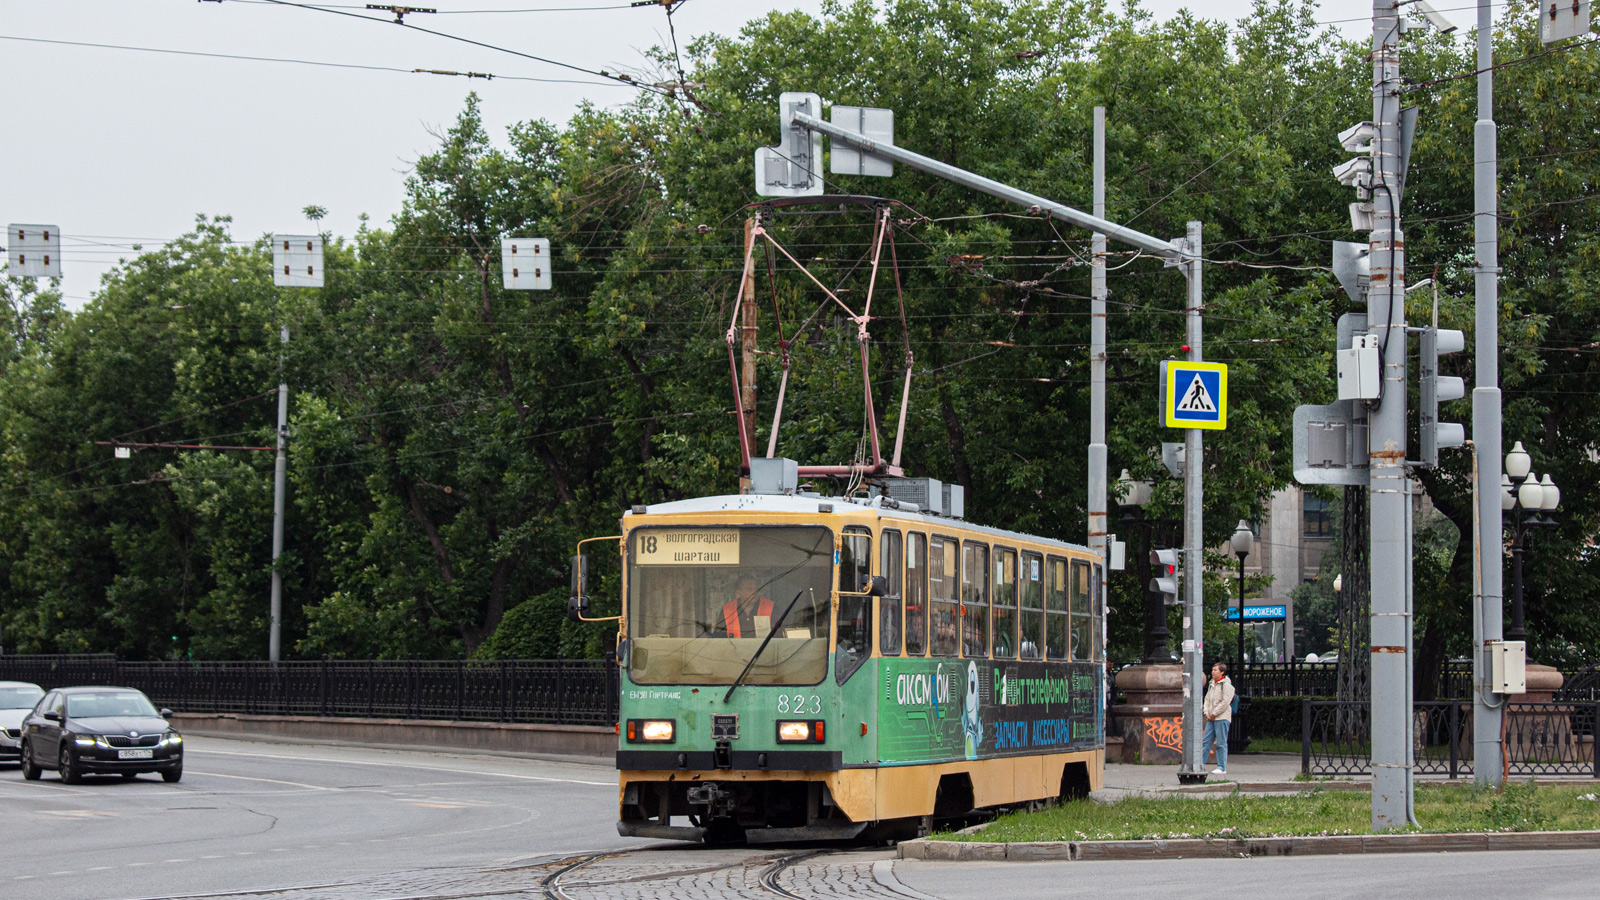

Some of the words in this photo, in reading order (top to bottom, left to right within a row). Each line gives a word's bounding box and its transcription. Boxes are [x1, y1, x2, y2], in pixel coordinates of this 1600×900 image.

[640, 536, 658, 554] 18
[666, 533, 738, 544] ВОЛГОГРАДСКАЯ
[674, 552, 720, 561] ШАРТАШ
[1243, 607, 1282, 616] МОРОЖЕНОЕ
[777, 694, 821, 714] 823
[995, 721, 1028, 749] ЗАПЧАСТИ
[1032, 719, 1070, 747] АКСЕССУАРЫ
